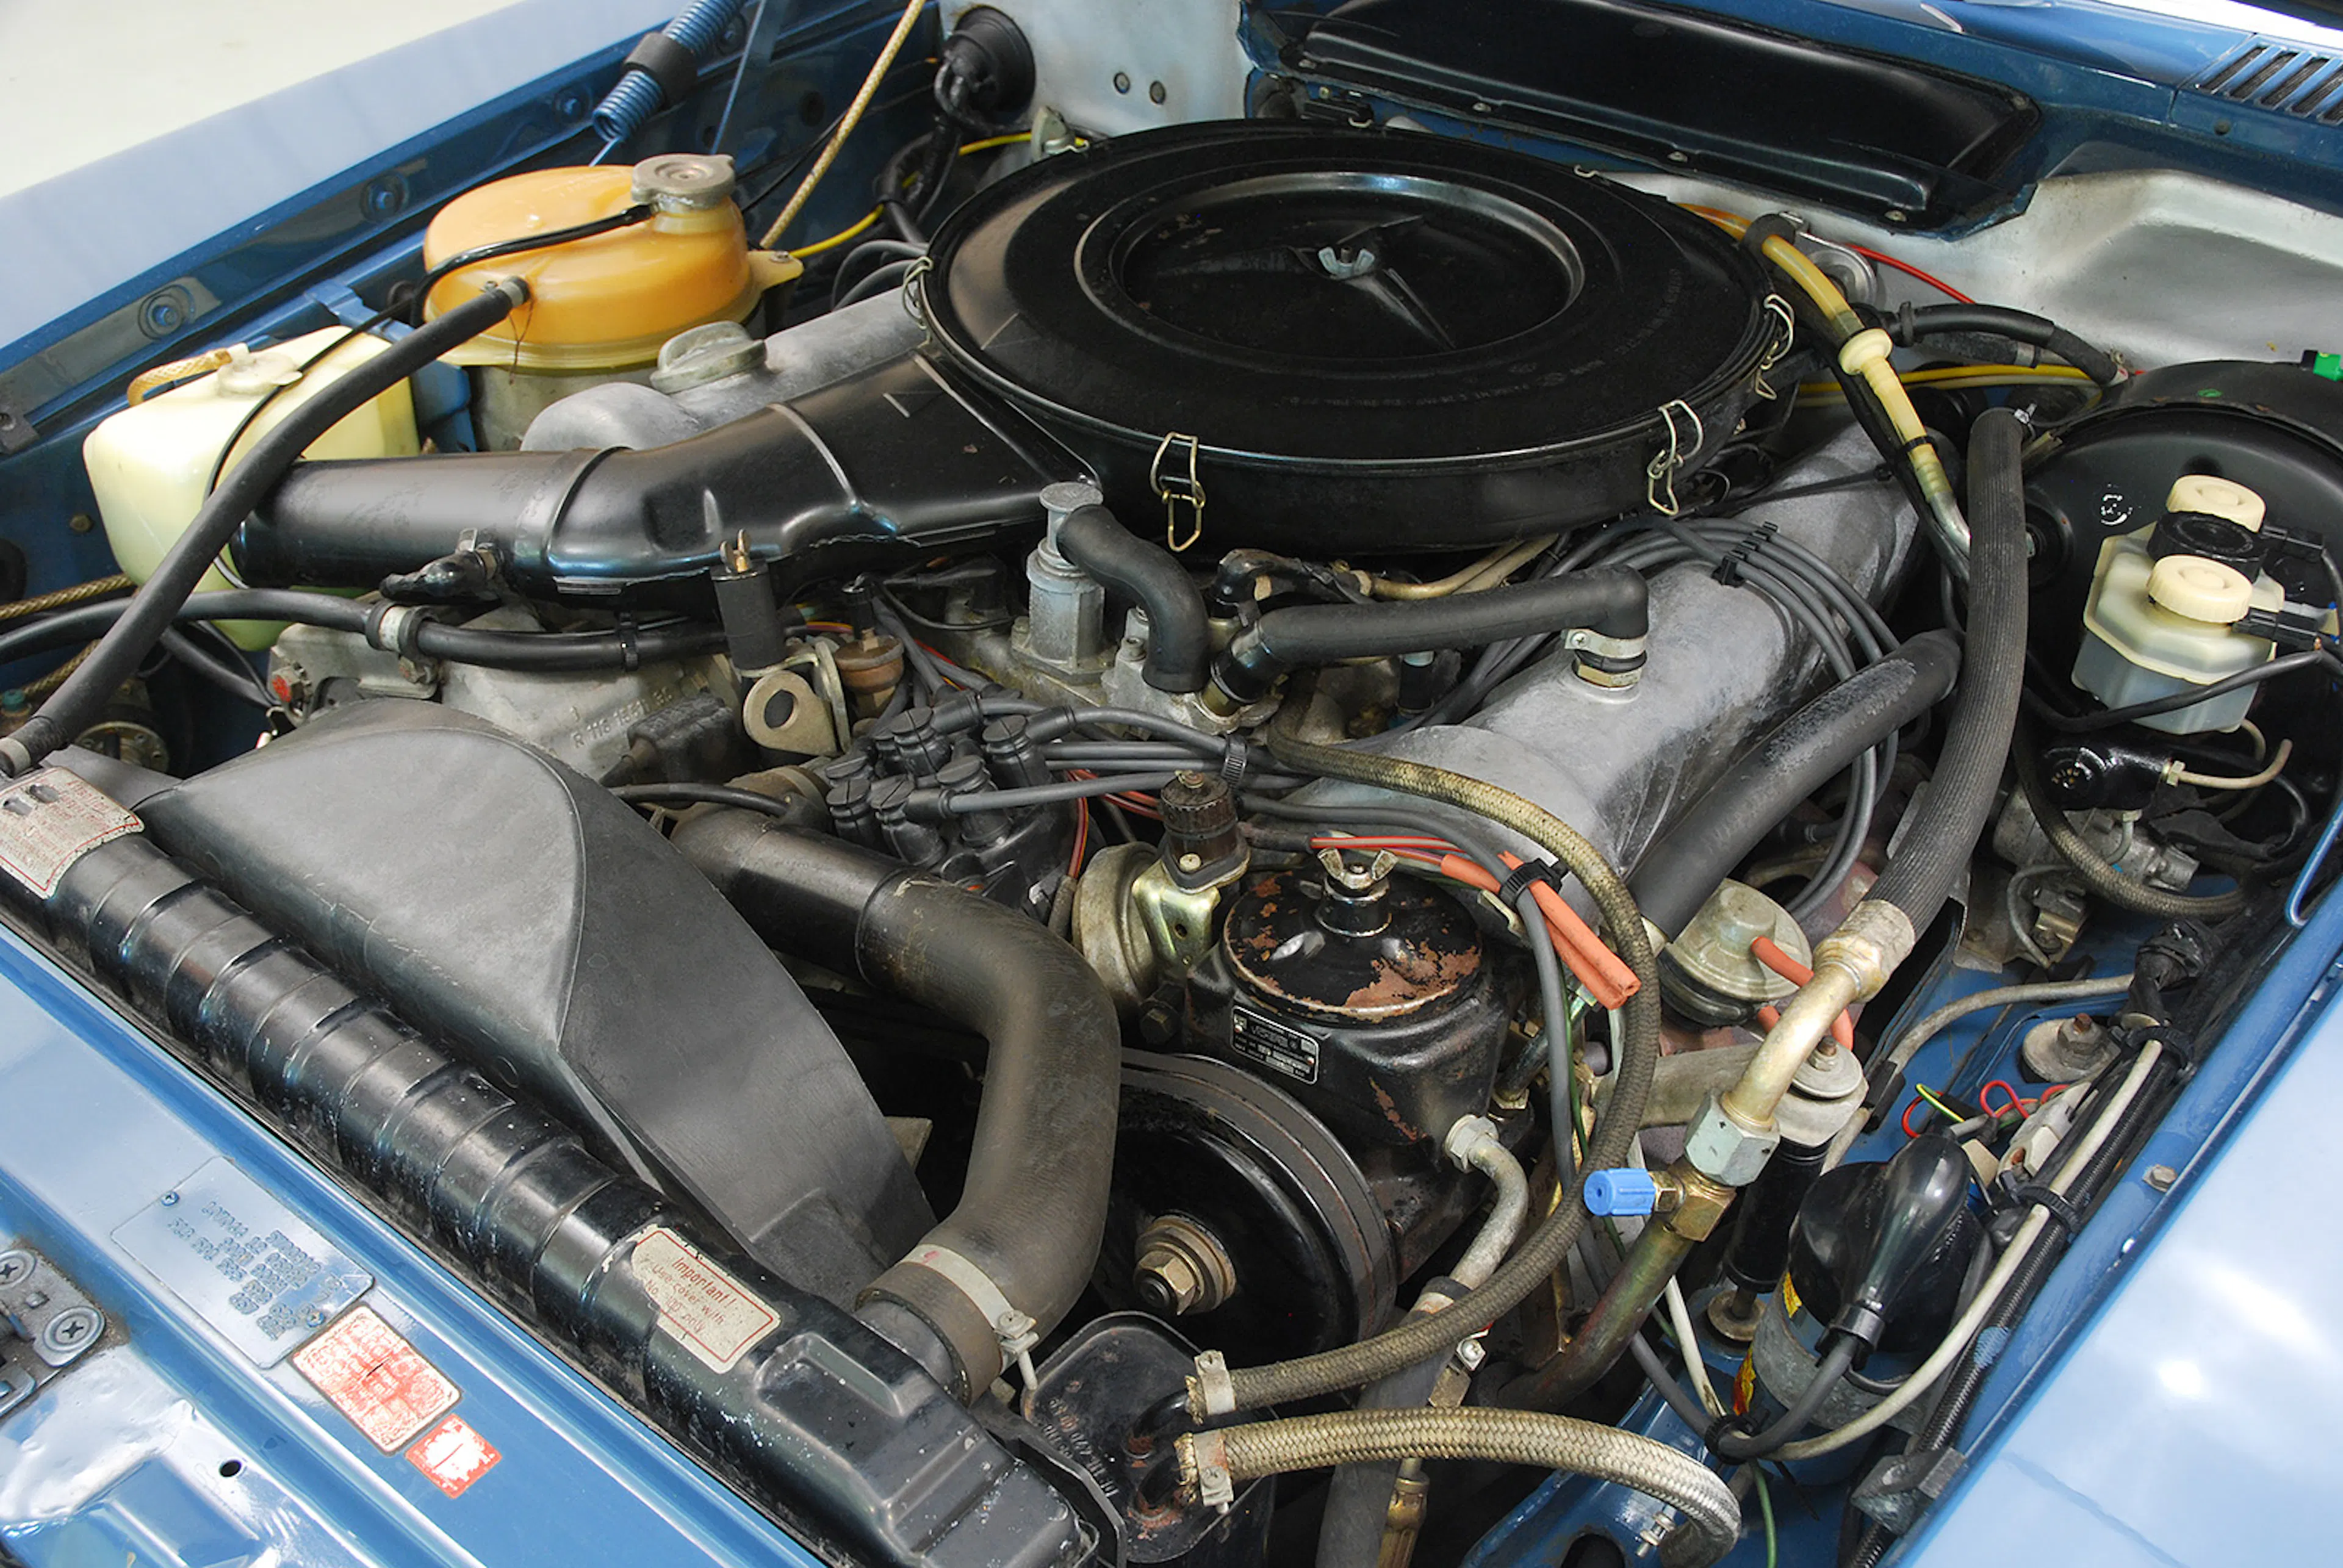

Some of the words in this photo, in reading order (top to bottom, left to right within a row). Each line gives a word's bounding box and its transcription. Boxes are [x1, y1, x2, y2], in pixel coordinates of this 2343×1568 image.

[652, 1264, 672, 1282] Use
[673, 1282, 700, 1304] cover
[702, 1304, 725, 1326] with
